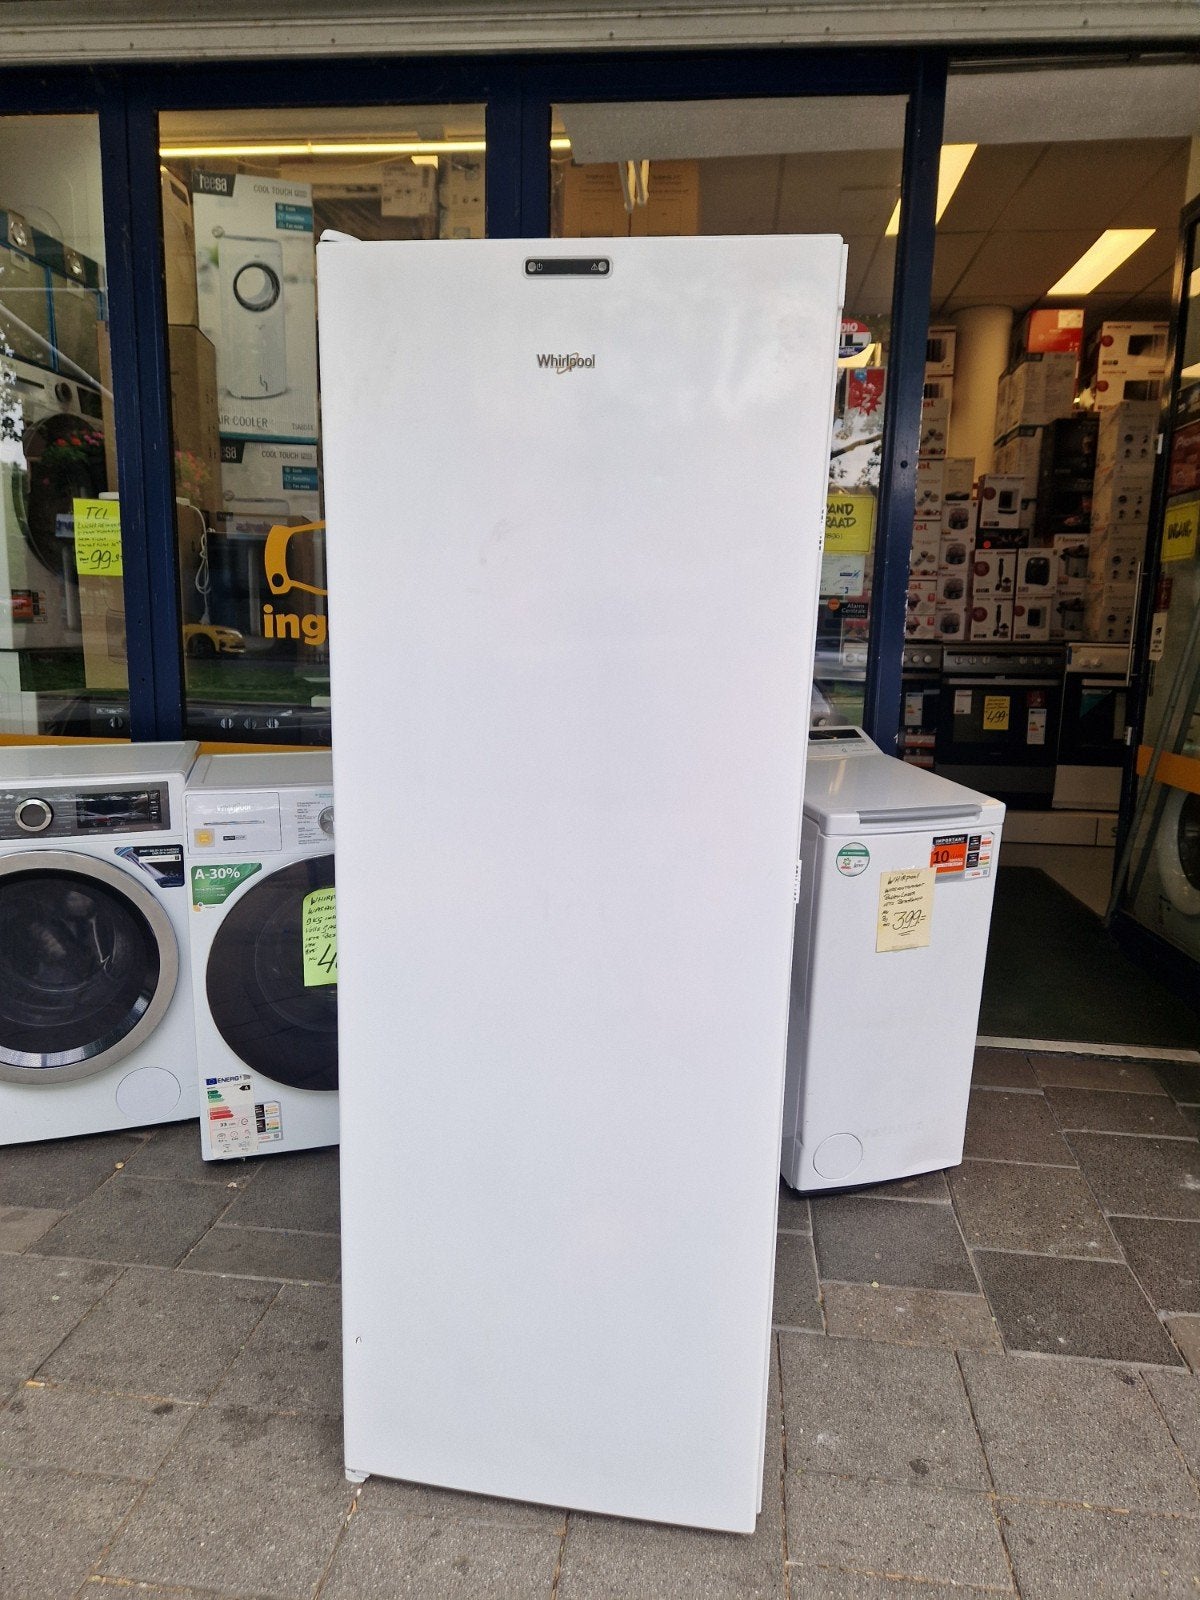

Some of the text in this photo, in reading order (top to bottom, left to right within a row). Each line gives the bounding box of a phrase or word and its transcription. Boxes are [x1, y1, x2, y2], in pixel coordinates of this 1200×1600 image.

[537, 352, 596, 375] Whirlpool
[232, 415, 269, 429] COOLER
[279, 451, 299, 460] TOUCH
[86, 506, 110, 520] TCL
[826, 502, 854, 516] AND
[263, 604, 327, 646] ing
[934, 836, 966, 844] IMPORTANT
[932, 850, 949, 864] 10
[194, 867, 241, 880] A-30%
[317, 943, 337, 974] 4
